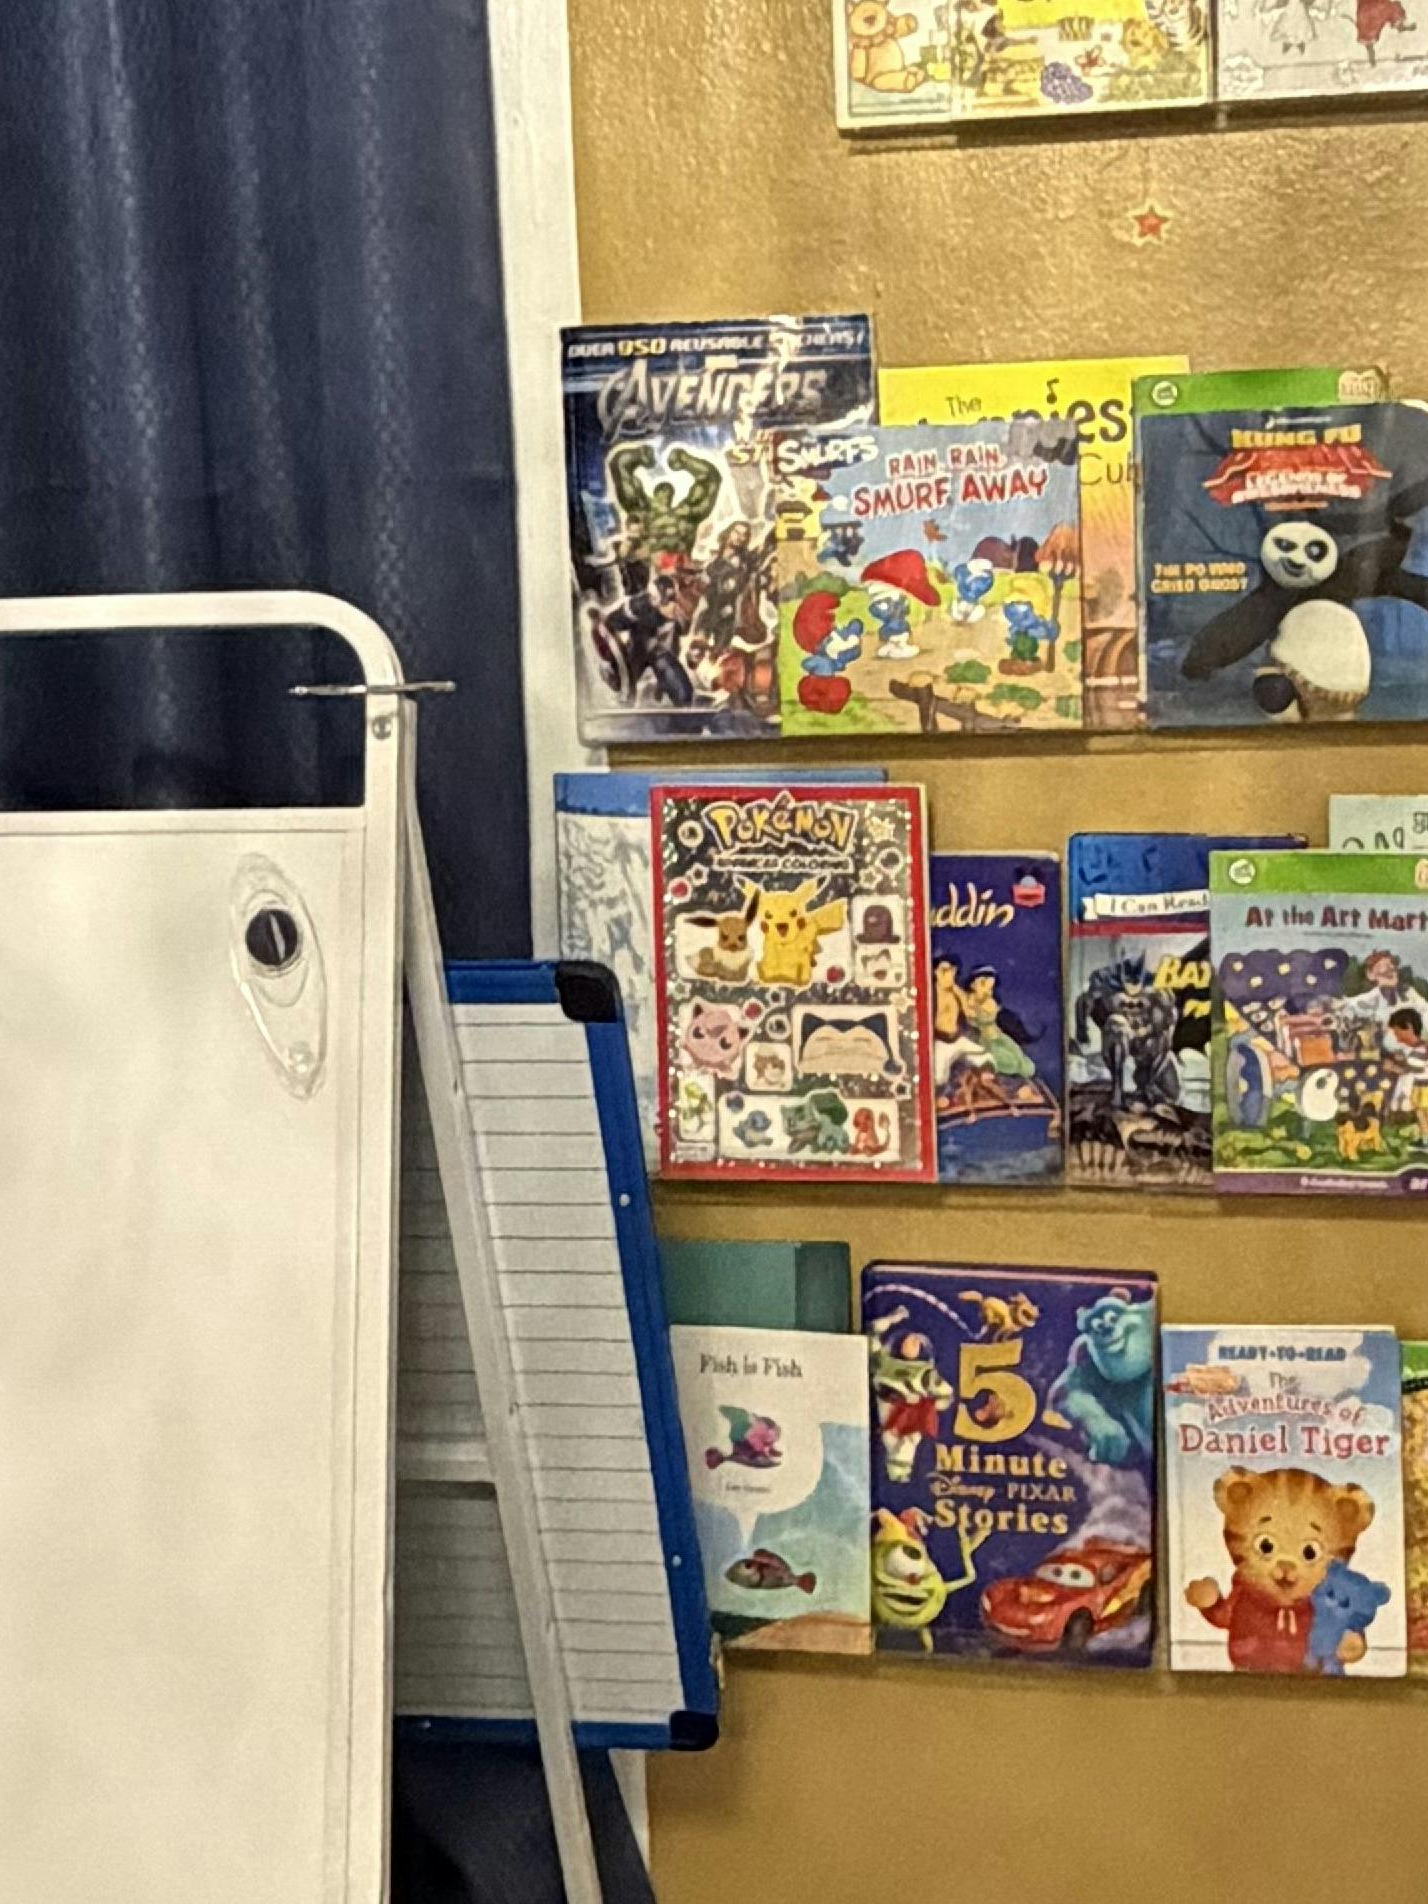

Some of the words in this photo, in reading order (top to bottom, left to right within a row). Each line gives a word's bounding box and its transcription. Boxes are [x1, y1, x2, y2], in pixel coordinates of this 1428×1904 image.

[945, 394, 982, 418] The
[853, 477, 950, 516] SMURF
[961, 467, 1048, 503] AWAY
[1320, 904, 1361, 928] Art
[700, 1353, 738, 1374] Fish
[763, 1356, 803, 1378] Fish
[954, 1338, 1037, 1443] 5
[1207, 1394, 1333, 1421] Adventures
[1338, 1405, 1367, 1428] of
[1179, 1423, 1289, 1455] Daniel
[1300, 1425, 1391, 1460] Tiger
[935, 1443, 1068, 1479] Minute
[925, 1471, 996, 1504] Disney
[1007, 1481, 1077, 1503] PIXAR
[934, 1498, 1069, 1535] Stories
